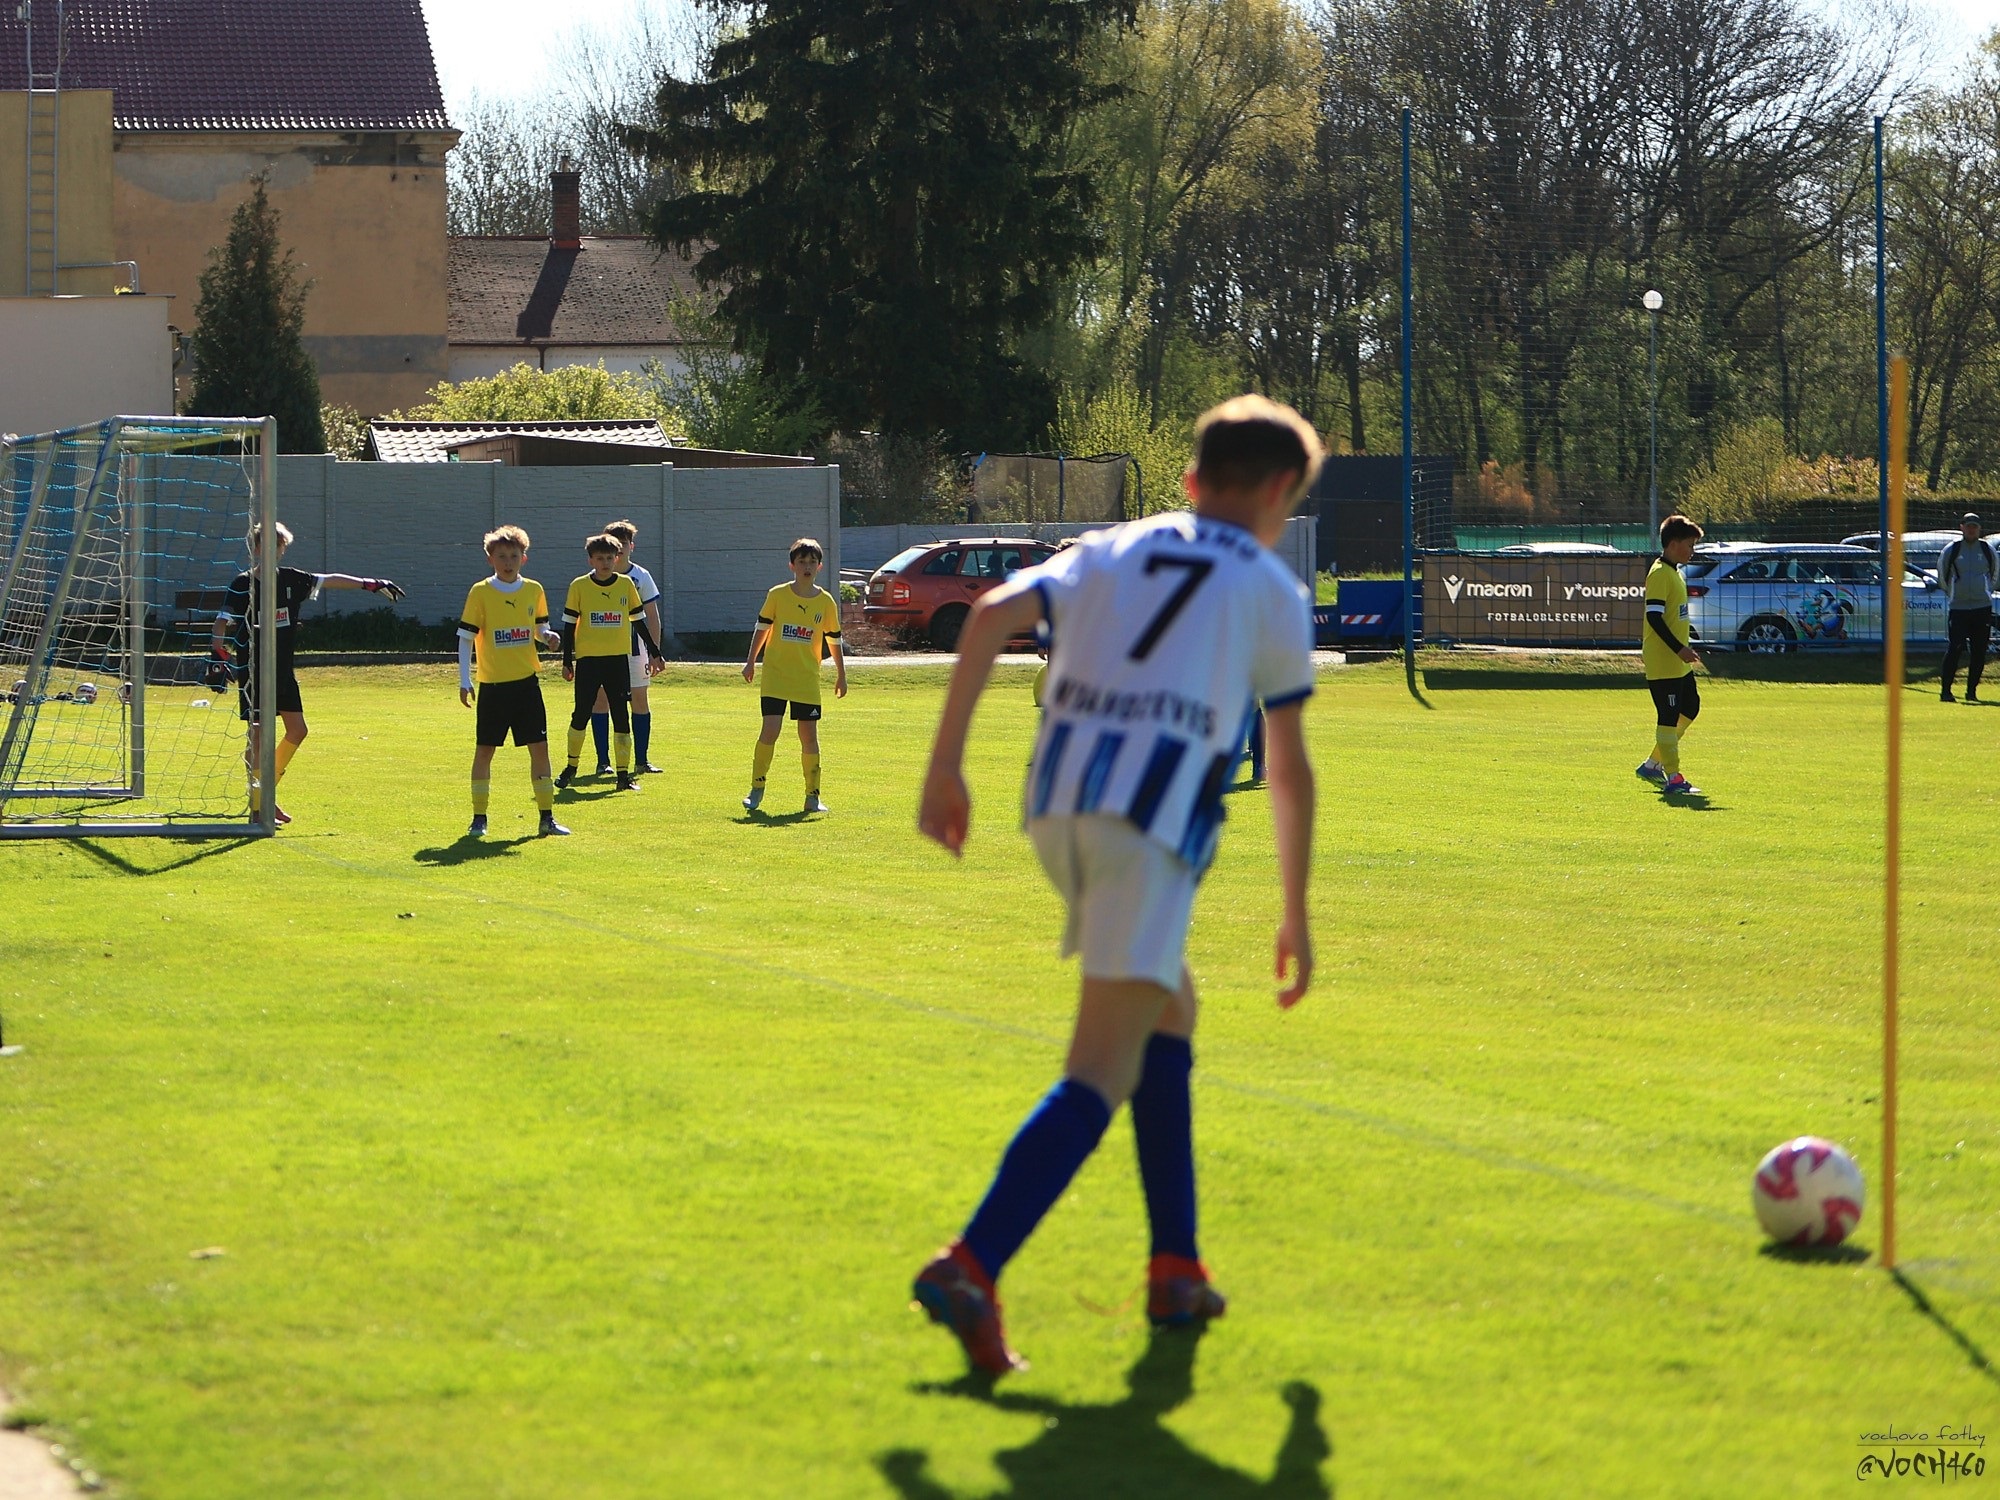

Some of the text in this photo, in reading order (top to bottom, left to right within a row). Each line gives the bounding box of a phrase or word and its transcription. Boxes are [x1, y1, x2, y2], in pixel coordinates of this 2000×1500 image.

[1466, 583, 1533, 597] macron
[1563, 583, 1646, 600] yourspor
[1131, 552, 1216, 662] 7
[590, 612, 622, 623] BigMat
[1487, 613, 1608, 622] FOTBALOBLECENI.CZ
[494, 628, 531, 642] BigMat
[782, 624, 813, 638] BigMat
